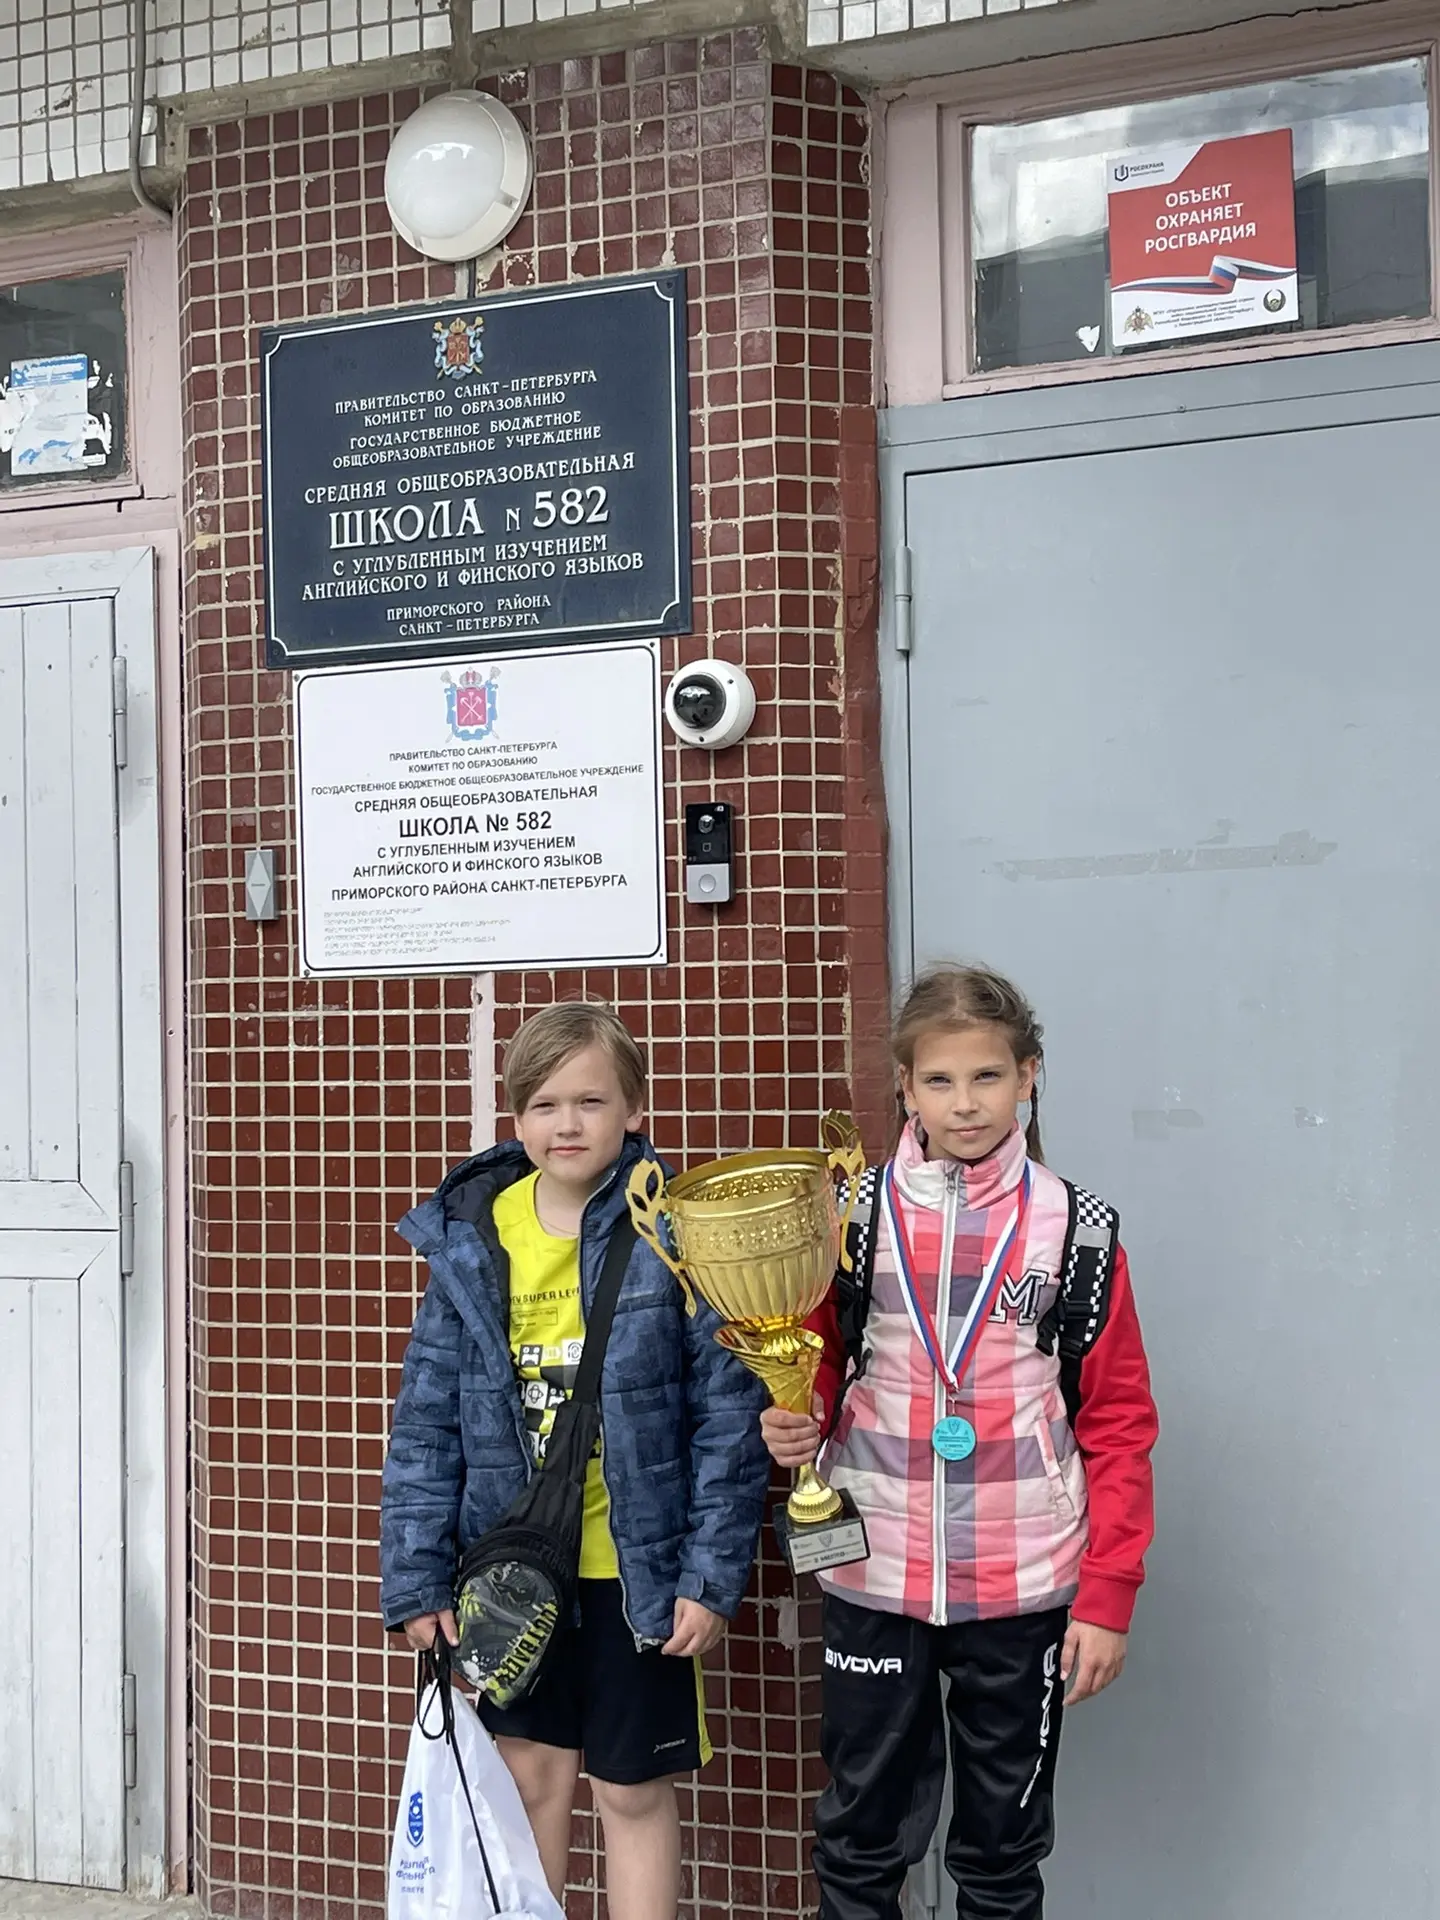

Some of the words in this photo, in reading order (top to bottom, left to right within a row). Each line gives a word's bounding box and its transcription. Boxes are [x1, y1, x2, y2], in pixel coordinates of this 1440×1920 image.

[1166, 183, 1232, 207] ОБЪЕКТ
[1156, 203, 1244, 230] ОХРАНЯЕТ
[1145, 222, 1255, 253] РОСГВАРДИЯ
[335, 389, 445, 414] ПРАВИТЕЛЬСТВО
[365, 408, 426, 427] КОМИТЕТ
[435, 405, 452, 418] ПО
[462, 391, 565, 415] ОБРАЗОВАНИЮ
[350, 423, 480, 449] ГОСУДАРСТВЕННОЕ
[490, 411, 581, 433] БЮДЖЕТНОЕ
[333, 438, 495, 468] ОБЩЕОБРАЗОВАТЕЛЬНОЕ
[506, 426, 601, 448] УЧРЕЖДЕНИЕ
[305, 480, 386, 504] СРЕДНЯЯ
[397, 452, 634, 493] ОБЩЕОБРАЗОВАТЕЛЬНАЯ
[329, 498, 484, 549] ШКОЛА
[533, 486, 608, 527] 582
[333, 560, 344, 576] С
[353, 546, 485, 574] УГЛУБЛЕННЫМ
[495, 534, 606, 560] ИЗУЧЕНИЕМ
[302, 574, 427, 600] АНГЛИЙСКОГО
[437, 571, 448, 587] И
[458, 561, 555, 585] ФИНСКОГО
[565, 552, 643, 575] ЯЗЫКОВ
[387, 601, 483, 620] ПРИМОРСКОГО
[497, 595, 551, 610] РАЙОНА
[389, 748, 465, 761] ПРАВИТЕЛЬСТВО
[467, 741, 557, 756] САНКТ-ПЕТЕРБУРГА
[409, 762, 449, 773] КОМИТЕТ
[452, 761, 465, 770] ПО
[467, 756, 538, 769] ОБРАЗОВАНИЮ
[311, 782, 396, 795] ГОСУДАРСТВЕННОЕ
[399, 777, 456, 789] БЮДЖЕТНОЕ
[458, 769, 577, 785] ОБЩЕОБРАЗОВАТЕЛЬНОЕ
[580, 764, 643, 776] УЧРЕЖДЕНИЕ
[355, 798, 416, 813] СРЕДНЯЯ
[420, 785, 597, 808] ОБЩЕОБРАЗОВАТЕЛЬНАЯ
[400, 816, 479, 838] ШКОЛА
[487, 814, 508, 833] №
[516, 811, 551, 831] 582
[377, 847, 386, 858] С
[390, 841, 489, 858] УГЛУБЛЕННЫМ
[494, 836, 575, 851] ИЗУЧЕНИЕМ
[353, 861, 448, 877] АНГЛИЙСКОГО
[453, 861, 461, 872] И
[465, 856, 540, 871] ФИНСКОГО
[544, 853, 602, 867] ЯЗЫКОВ
[332, 885, 429, 900] ПРИМОРСКОГО
[433, 882, 487, 895] РАЙОНА
[491, 874, 627, 893] САНКТ-ПЕТЕРБУРГА
[522, 1289, 556, 1304] SUPER
[981, 1264, 1049, 1326] M
[825, 1647, 902, 1674] GIVOVA
